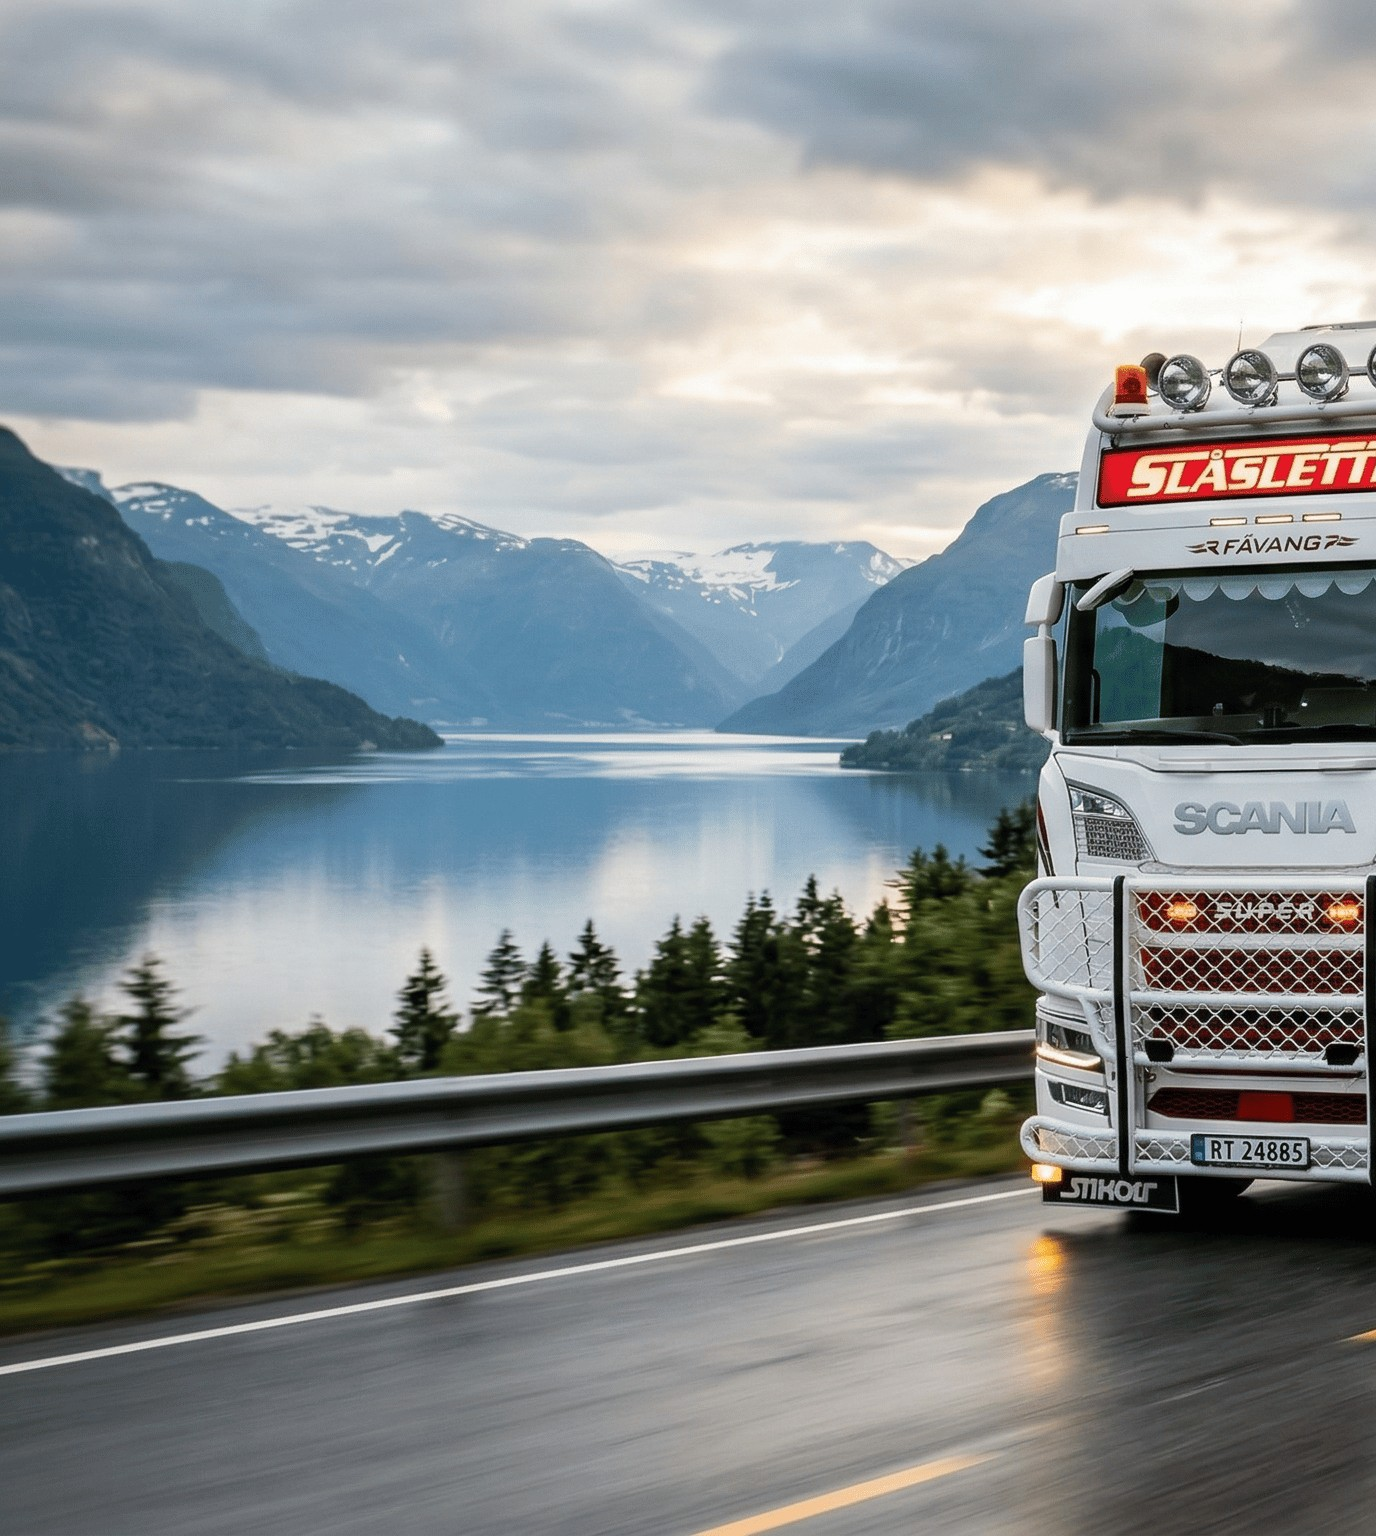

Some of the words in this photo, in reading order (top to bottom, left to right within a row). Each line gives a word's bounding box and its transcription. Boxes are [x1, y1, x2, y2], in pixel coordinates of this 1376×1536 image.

[1173, 800, 1357, 836] SCANIA
[1214, 901, 1315, 921] SUPER
[1211, 1139, 1235, 1160] RT
[1241, 1140, 1303, 1163] 24885
